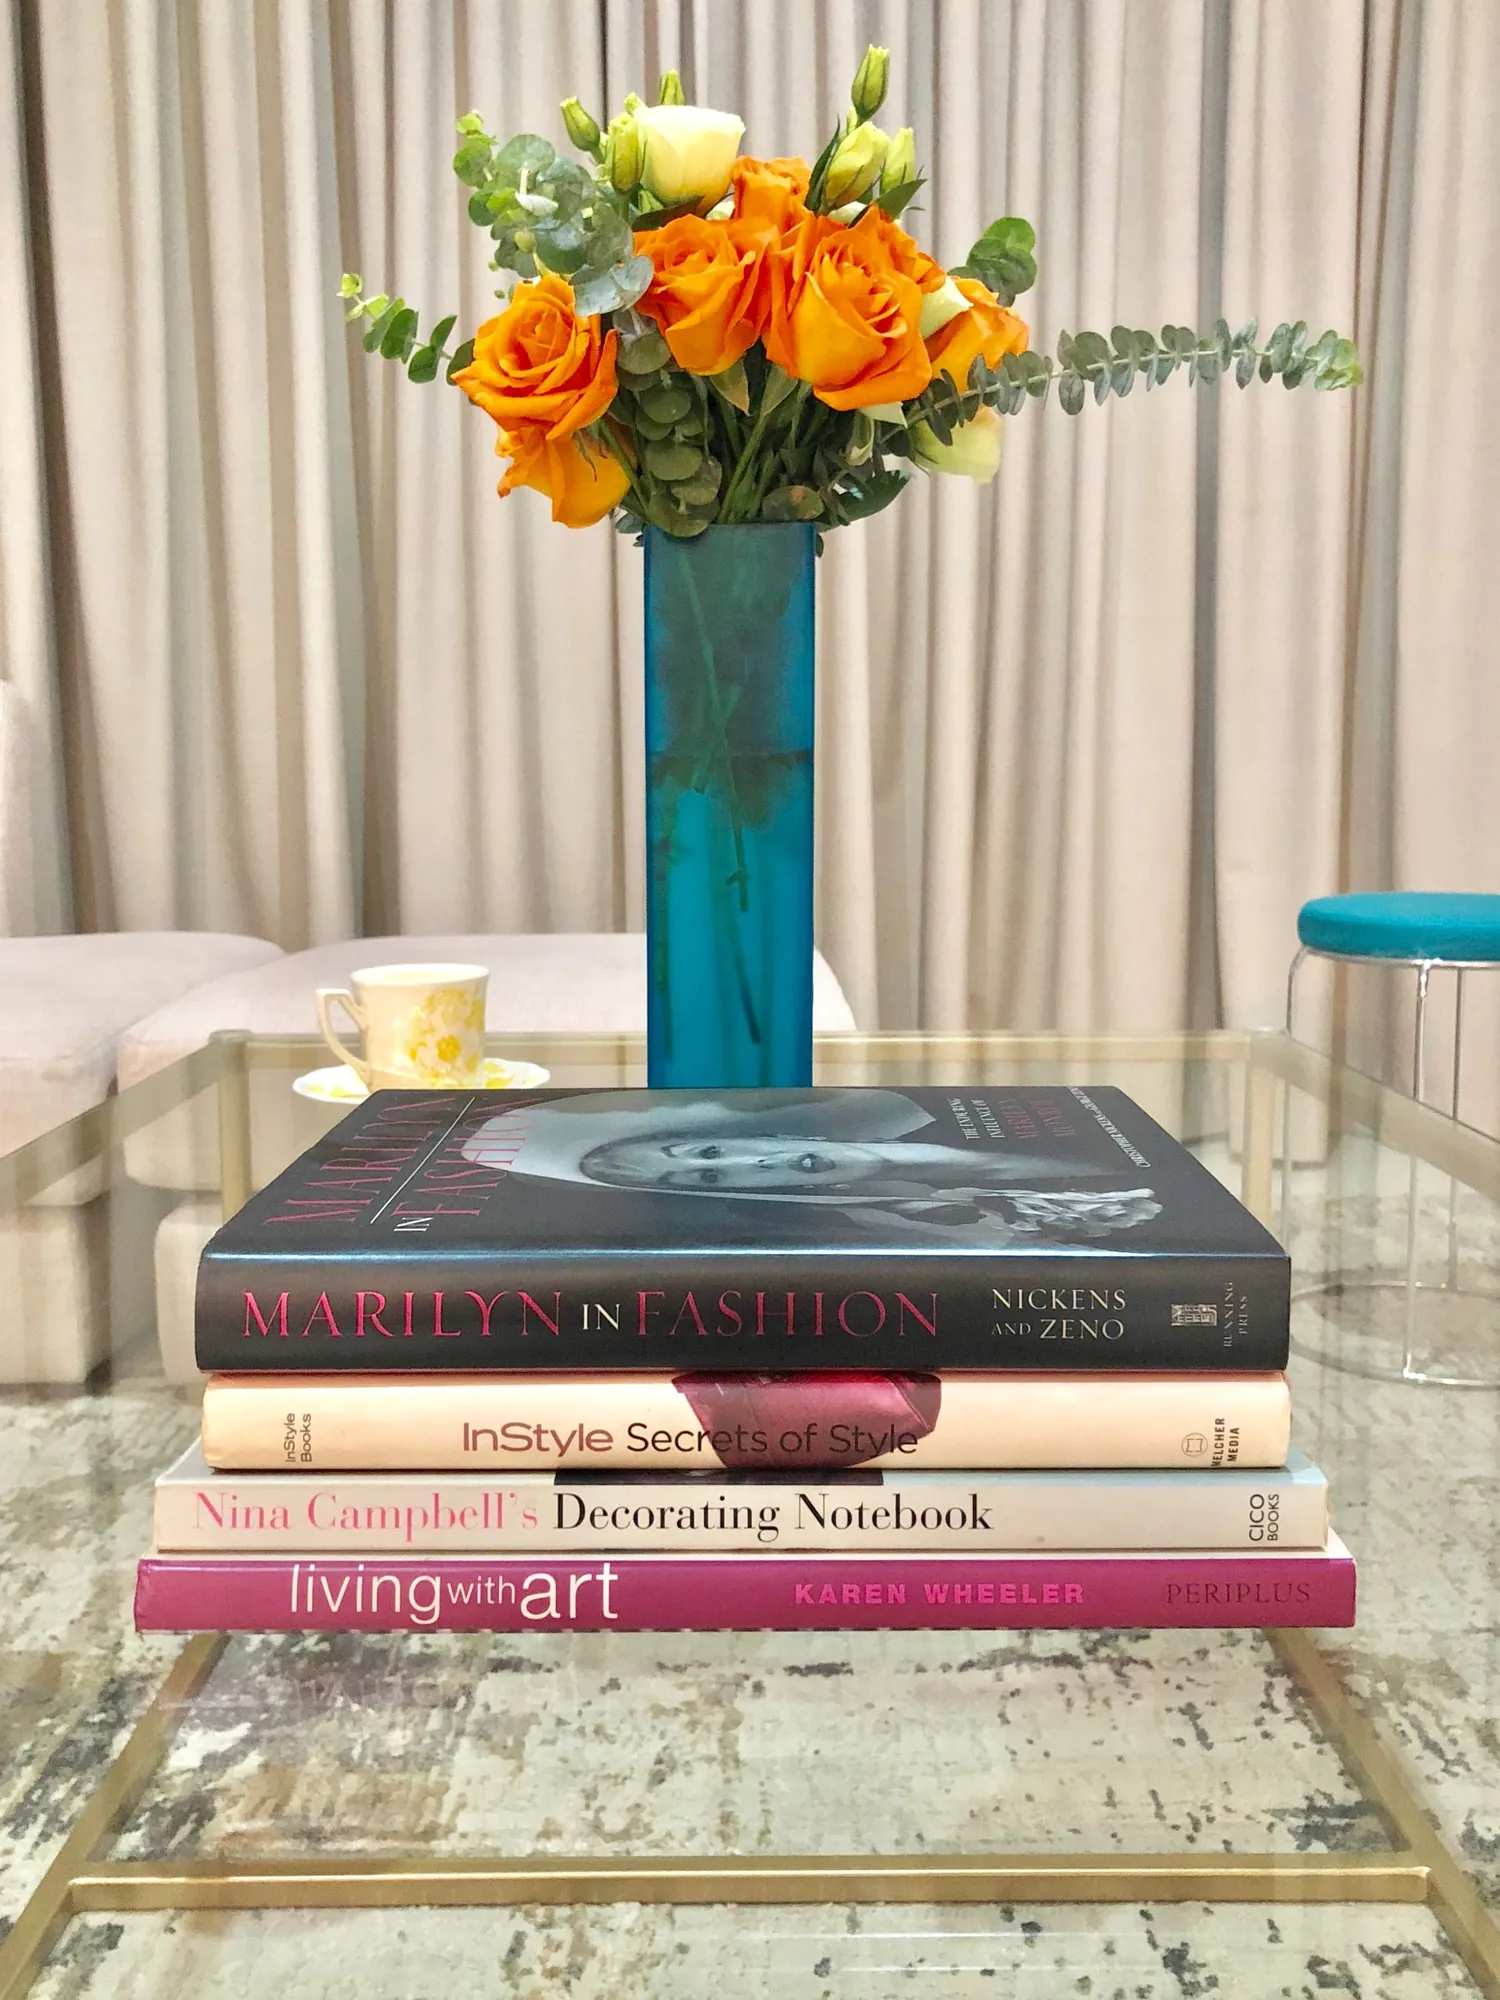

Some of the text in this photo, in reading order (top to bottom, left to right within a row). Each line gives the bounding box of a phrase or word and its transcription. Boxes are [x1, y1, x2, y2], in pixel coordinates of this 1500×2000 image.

[265, 1097, 456, 1224] MARILYN
[391, 1098, 543, 1217] FASHION
[393, 1217, 434, 1232] IN
[243, 1291, 940, 1338] MARILYN IN FASHION
[992, 1288, 1127, 1311] NICKENS
[991, 1318, 1125, 1341] AND ZENO
[285, 1412, 297, 1463] InStyle
[300, 1413, 312, 1463] Books
[462, 1422, 919, 1457] InStyle Secrets of Style
[1210, 1418, 1225, 1467] MELCHER
[1227, 1427, 1239, 1461] MEDIA
[192, 1491, 994, 1543] Nina Campbell's Decorating Notebook
[1249, 1493, 1265, 1542] CICO
[1266, 1493, 1280, 1542] BOOKS
[290, 1562, 620, 1625] living with art
[795, 1583, 1085, 1605] KAREN WHEELER
[1167, 1583, 1312, 1605] PERIPLUS
